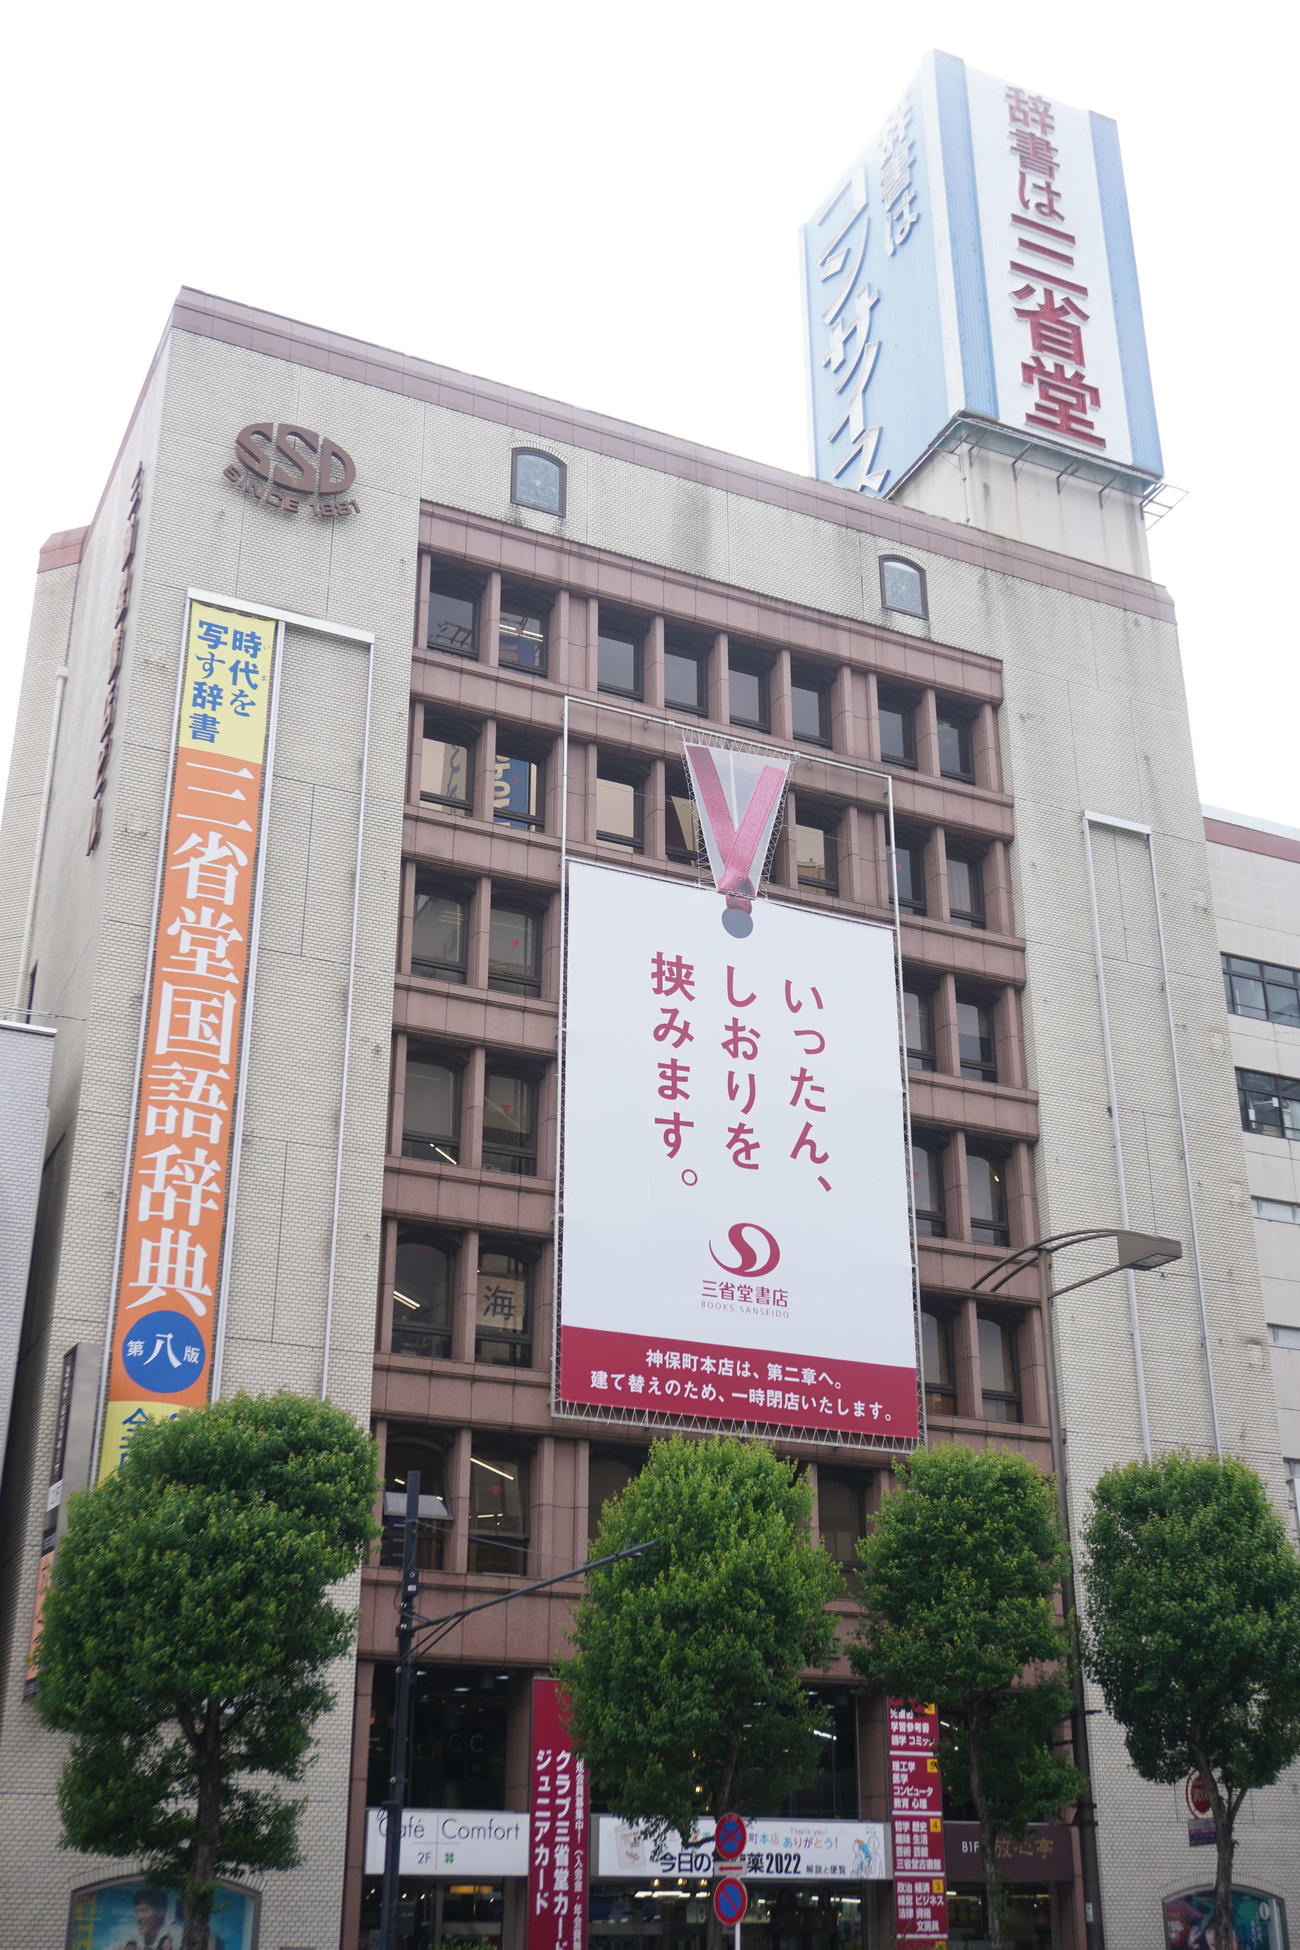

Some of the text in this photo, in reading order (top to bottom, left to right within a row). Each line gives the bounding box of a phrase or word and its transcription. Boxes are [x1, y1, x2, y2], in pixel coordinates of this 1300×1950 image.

[1004, 85, 1107, 449] 辞書は三省堂
[235, 422, 356, 496] SSD
[223, 464, 360, 517] SINCE 1881
[188, 619, 229, 743] 写す辞書
[228, 629, 262, 718] 時代を
[126, 761, 255, 1317] 三省堂国語辞典
[651, 950, 698, 1187] 挟みます。
[721, 965, 761, 1170] しおりを
[785, 978, 832, 1193] いったん、
[701, 1280, 789, 1308] 三省堂書店
[701, 1300, 790, 1319] BOOKS SANSEIDO
[126, 1332, 201, 1369] 第八版
[646, 1348, 842, 1390] 神保町本店は、第二章へ。
[590, 1370, 892, 1422] 建て替えのため、一時閉店いたします。
[893, 1785, 933, 1797] コンピュータ
[442, 1817, 520, 1840] Comfort
[534, 1748, 552, 1916] ジュニアカード
[961, 1841, 979, 1853] B1F
[417, 1851, 432, 1865] 2F
[915, 1894, 944, 1906] ビジネス
